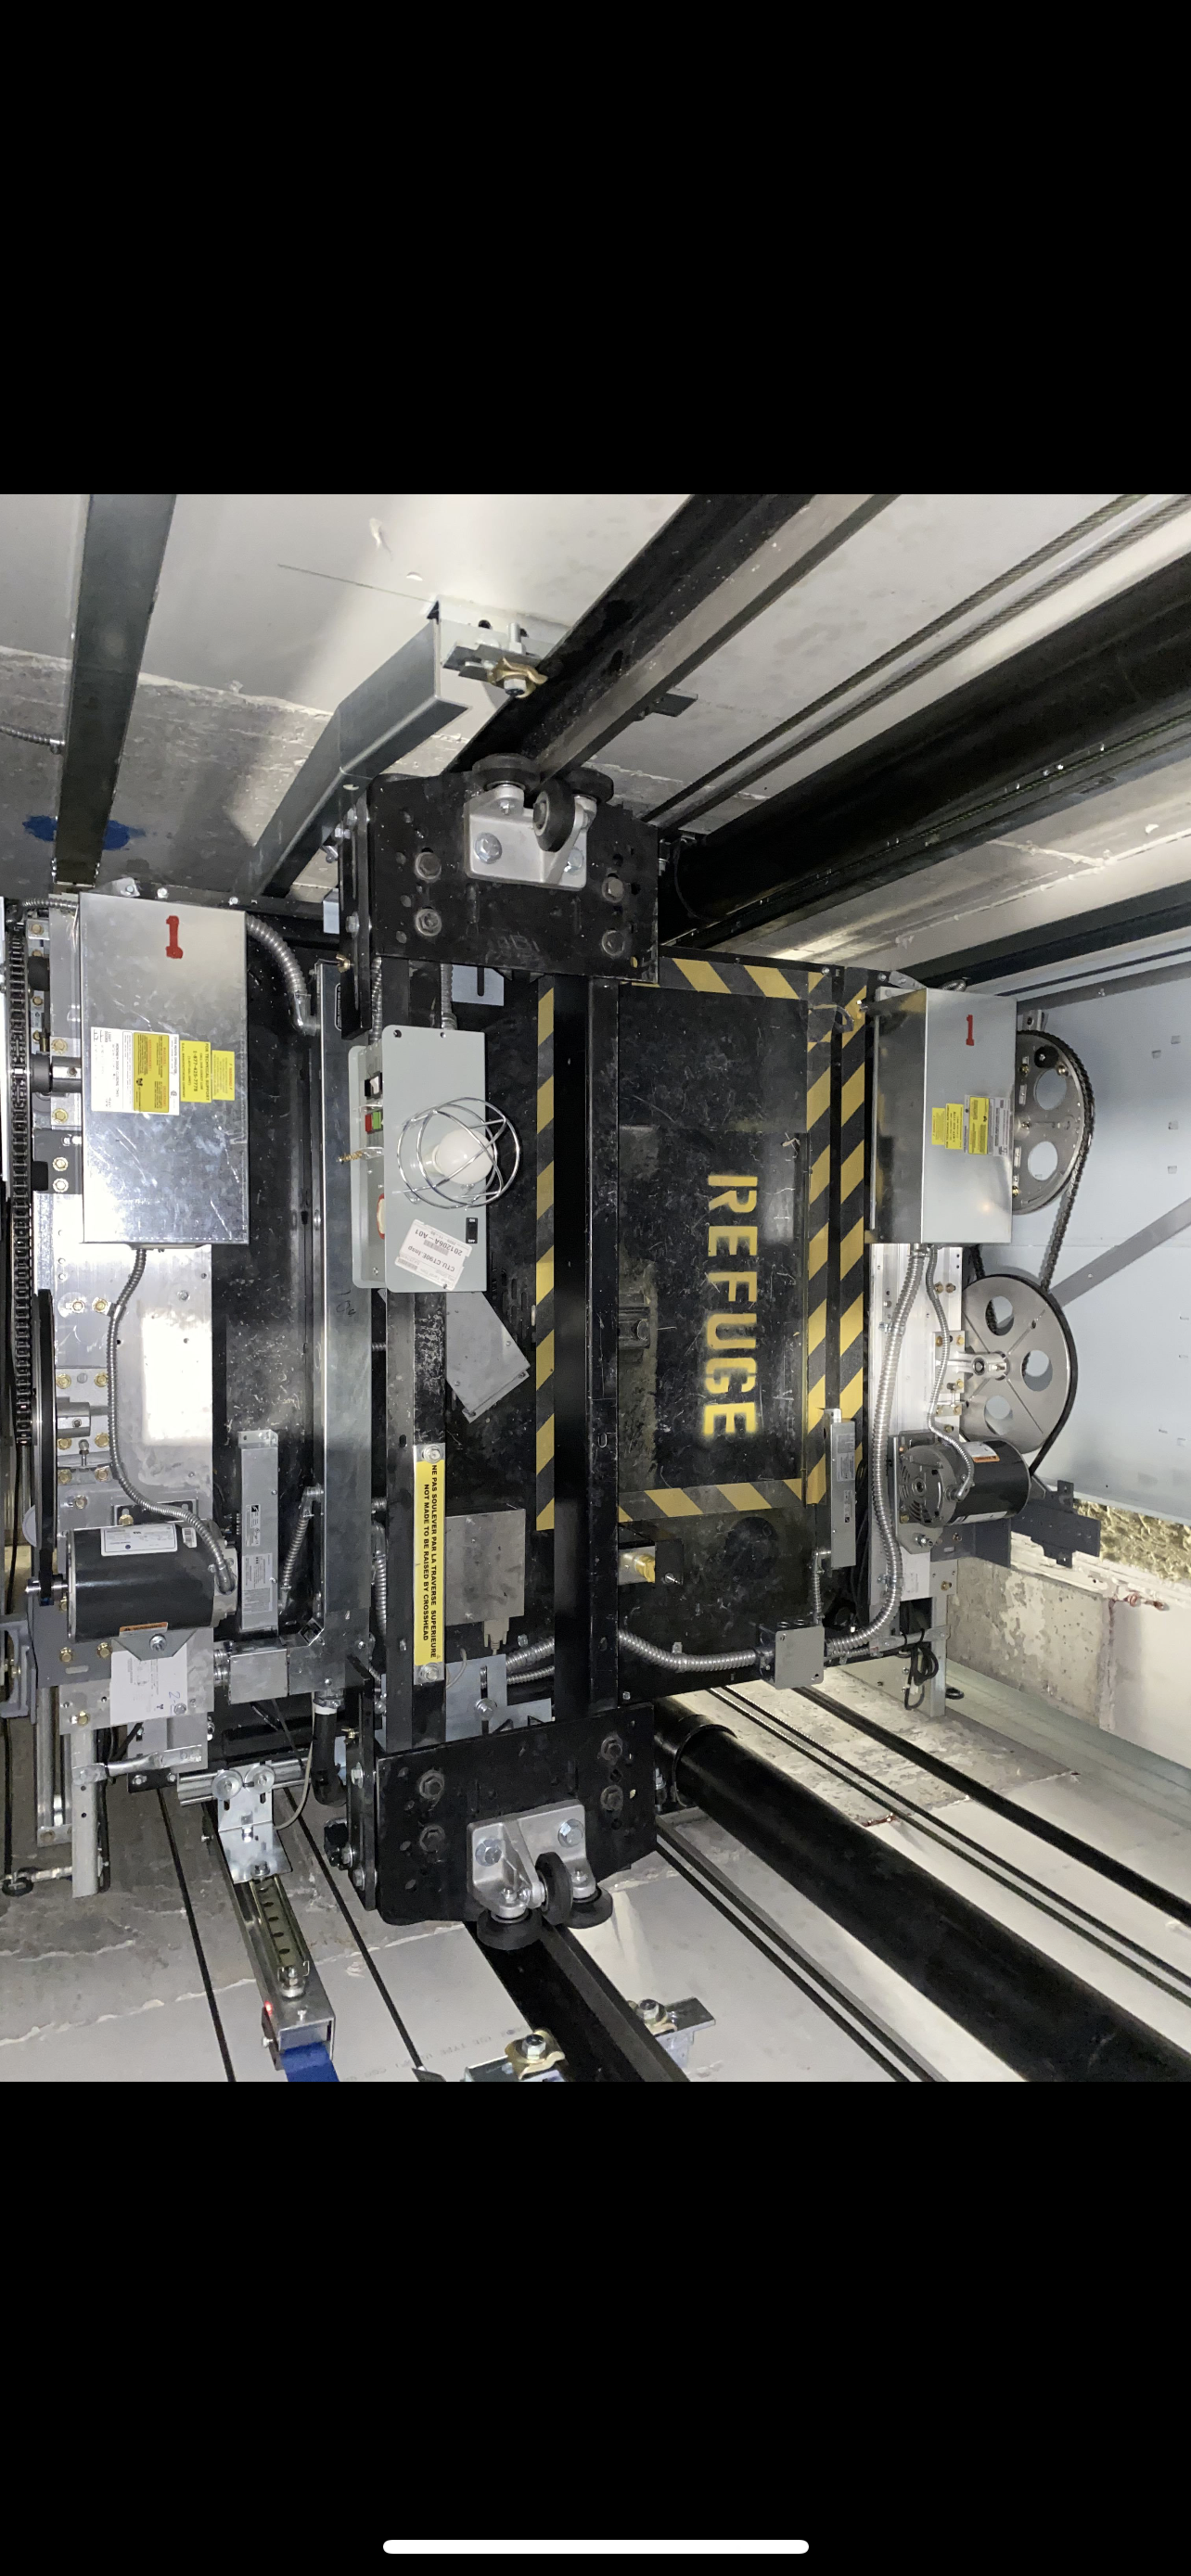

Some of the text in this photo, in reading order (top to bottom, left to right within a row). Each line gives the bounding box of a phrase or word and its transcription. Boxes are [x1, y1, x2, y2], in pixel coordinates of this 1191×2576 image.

[165, 914, 184, 959] 1
[966, 1014, 975, 1046] 1
[704, 1175, 758, 1435] REFUGE
[431, 1464, 438, 1475] NE
[424, 1526, 429, 1537] TO
[424, 1538, 429, 1549] BE
[431, 1554, 437, 1563] LA
[424, 1581, 429, 1591] BY
